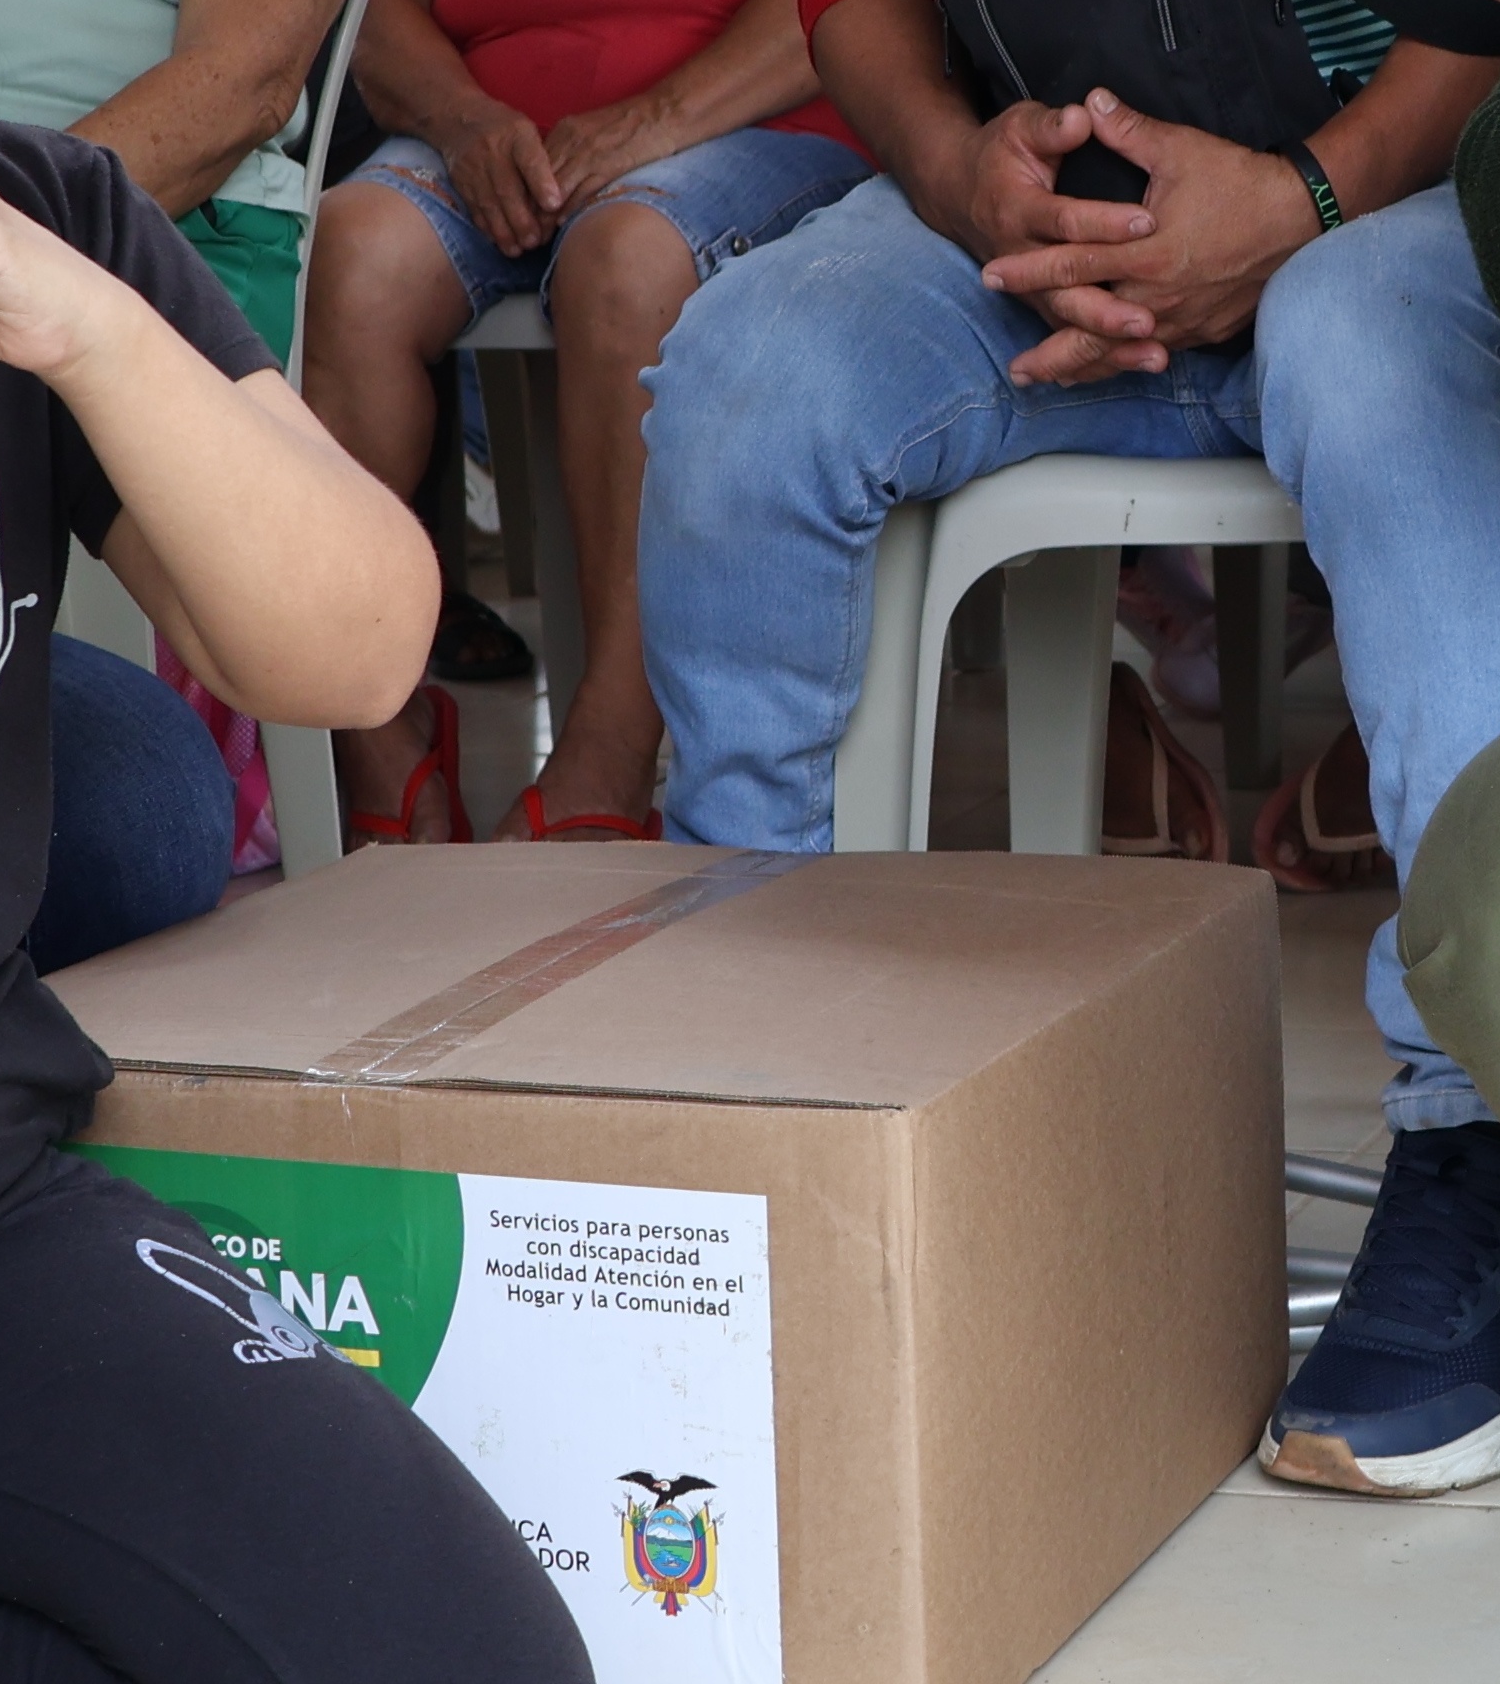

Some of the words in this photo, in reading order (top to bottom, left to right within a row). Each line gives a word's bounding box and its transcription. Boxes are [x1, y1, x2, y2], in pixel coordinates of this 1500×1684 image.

[490, 1210, 579, 1233] Servicios
[587, 1221, 631, 1238] para
[638, 1223, 730, 1243] personas
[252, 1238, 281, 1261] DE
[526, 1240, 562, 1256] con
[570, 1241, 700, 1266] discapacidad
[485, 1259, 587, 1282] Modalidad
[594, 1267, 684, 1289] Atención
[692, 1276, 717, 1291] en
[725, 1275, 744, 1293] el
[507, 1285, 564, 1308] Hogar
[572, 1293, 583, 1310] y
[591, 1290, 608, 1308] la
[615, 1292, 730, 1316] Comunidad
